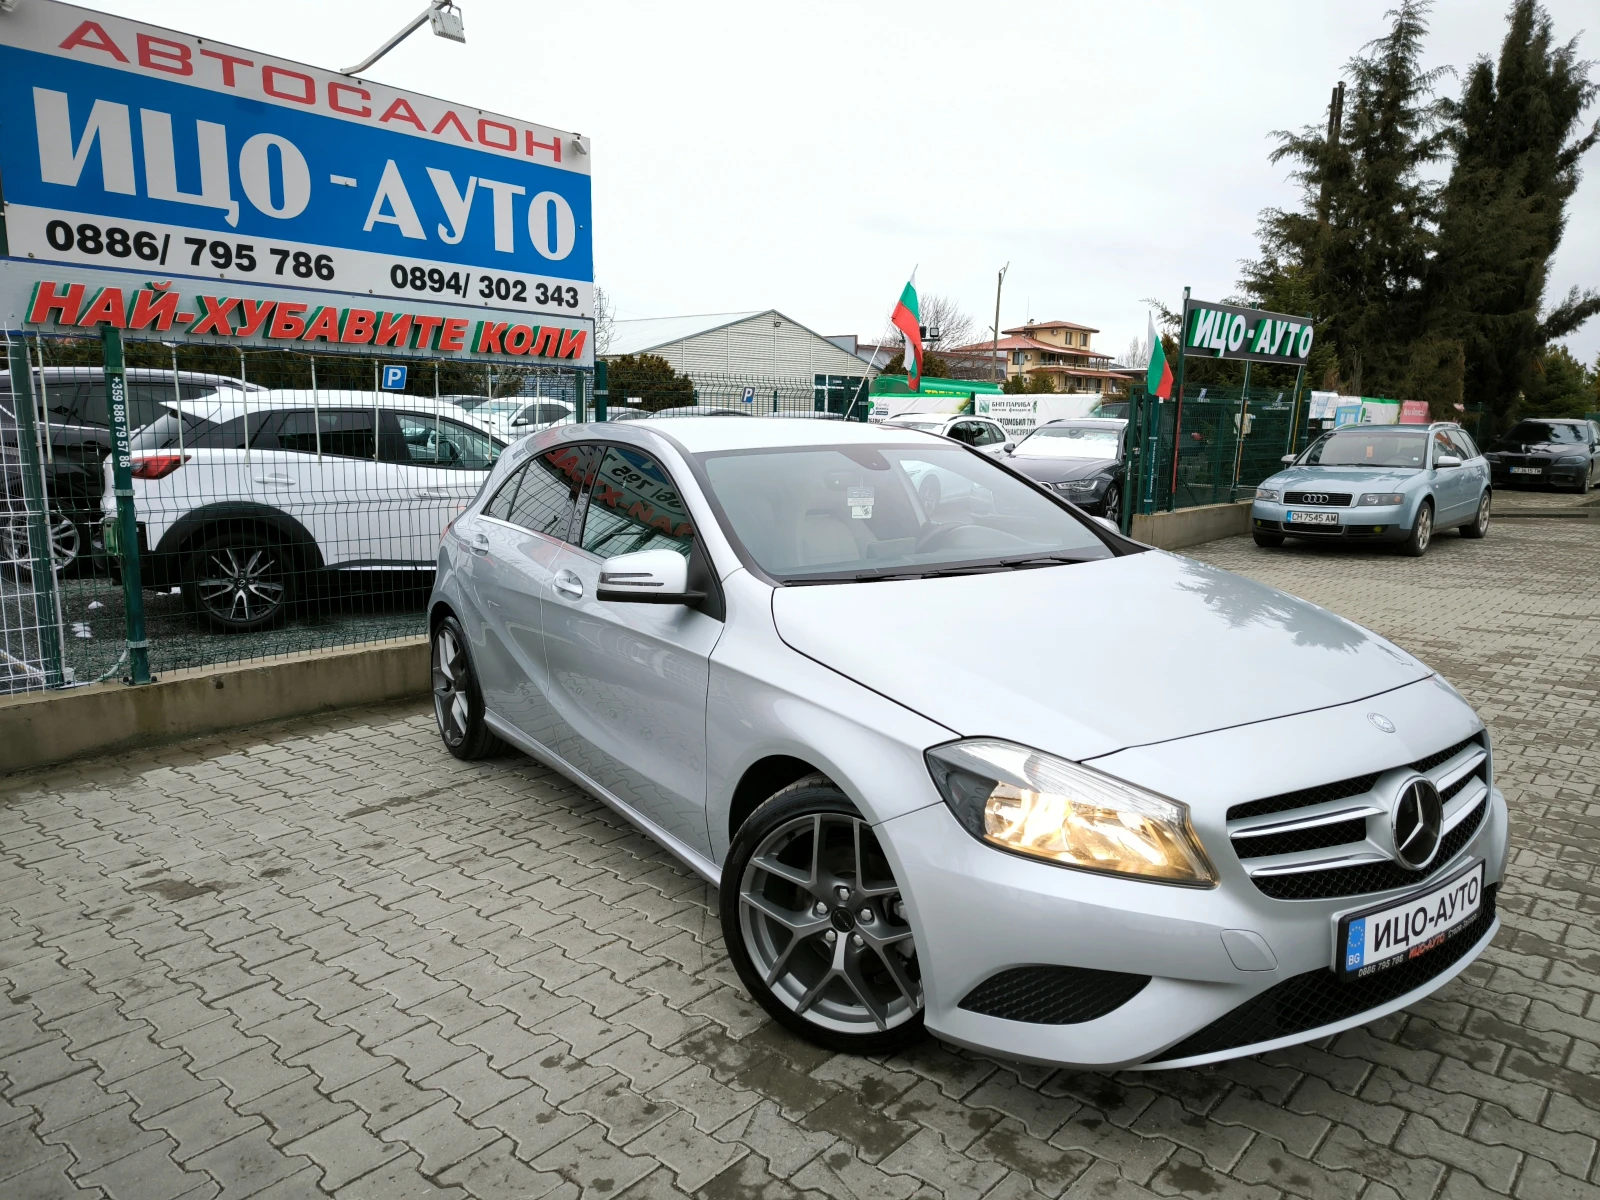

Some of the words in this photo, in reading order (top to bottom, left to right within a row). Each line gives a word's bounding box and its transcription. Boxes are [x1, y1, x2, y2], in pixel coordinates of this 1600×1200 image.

[58, 20, 562, 163] АВТОСАЛОН
[45, 219, 171, 265] 0886/
[184, 236, 257, 272] 795
[269, 247, 335, 281] 786
[390, 263, 471, 299] 0894/
[478, 275, 527, 303] 302
[535, 282, 579, 309] 343
[26, 279, 470, 352] НАЙ-ХУБАВИТЕ
[473, 320, 588, 359] КОЛИ
[1190, 308, 1314, 358] ИЦО-АУТО
[387, 368, 402, 386] P
[111, 376, 124, 402] +359
[113, 404, 125, 423] 886
[115, 425, 127, 438] 79
[117, 440, 129, 453] 57
[119, 455, 131, 468] 86
[1292, 512, 1303, 521] CH
[1303, 513, 1324, 522] 7545
[1325, 514, 1337, 523] AM
[1373, 875, 1479, 953] ИЦО-АУТО
[1348, 952, 1360, 966] BG
